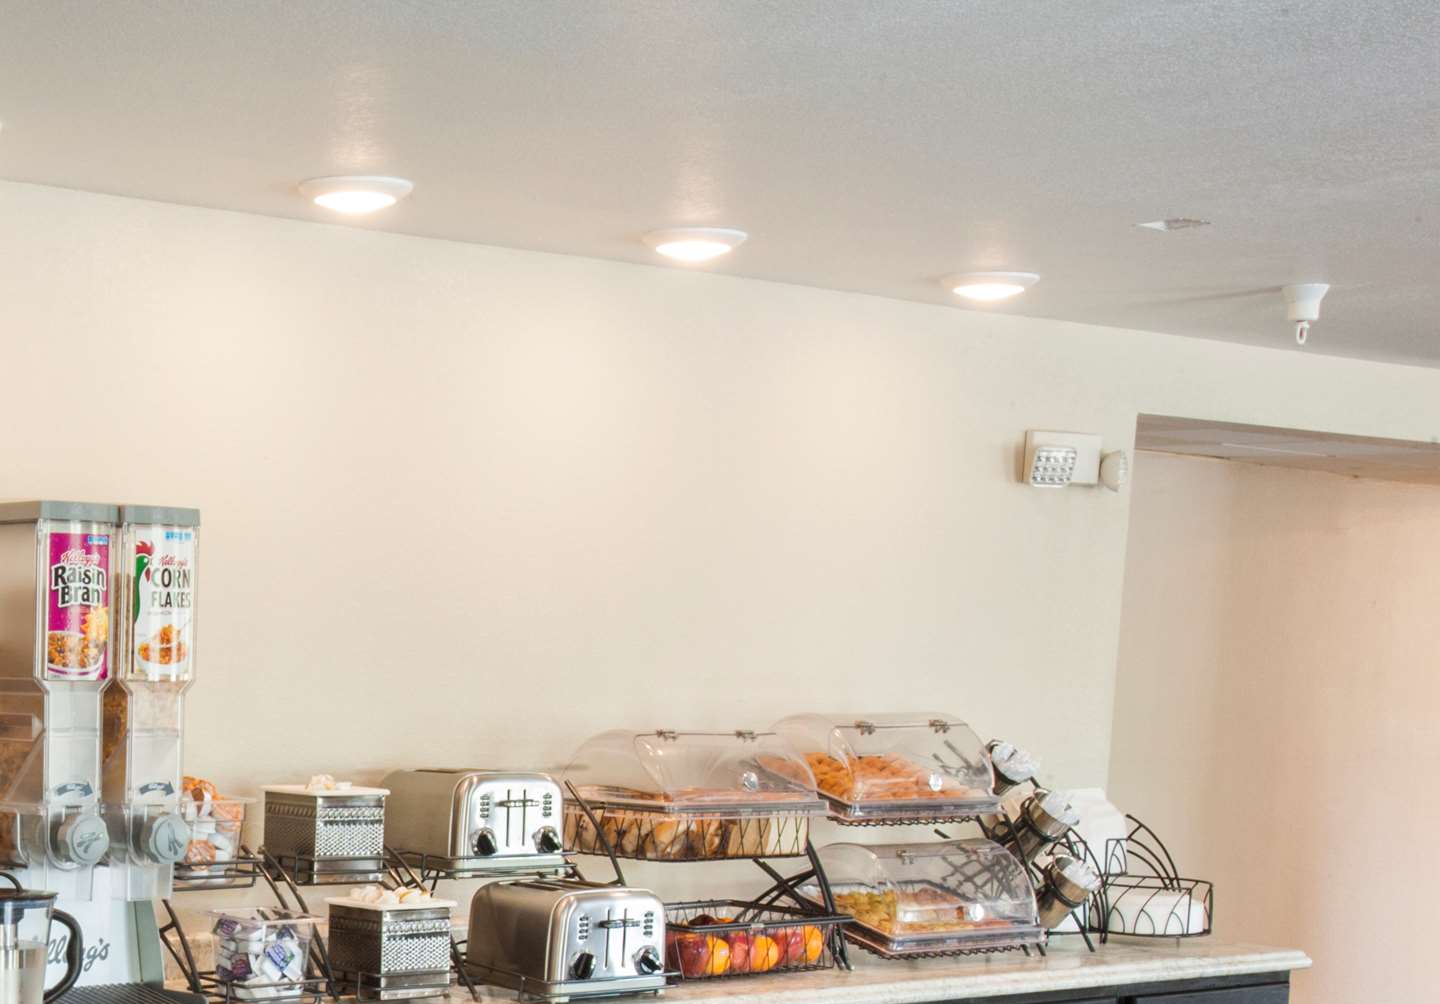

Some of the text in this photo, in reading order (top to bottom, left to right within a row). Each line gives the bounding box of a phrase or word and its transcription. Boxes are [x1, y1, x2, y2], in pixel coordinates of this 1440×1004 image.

[53, 565, 105, 590] Raisin
[151, 567, 191, 589] CORN
[60, 585, 100, 605] Bran
[151, 591, 191, 608] FLAKES
